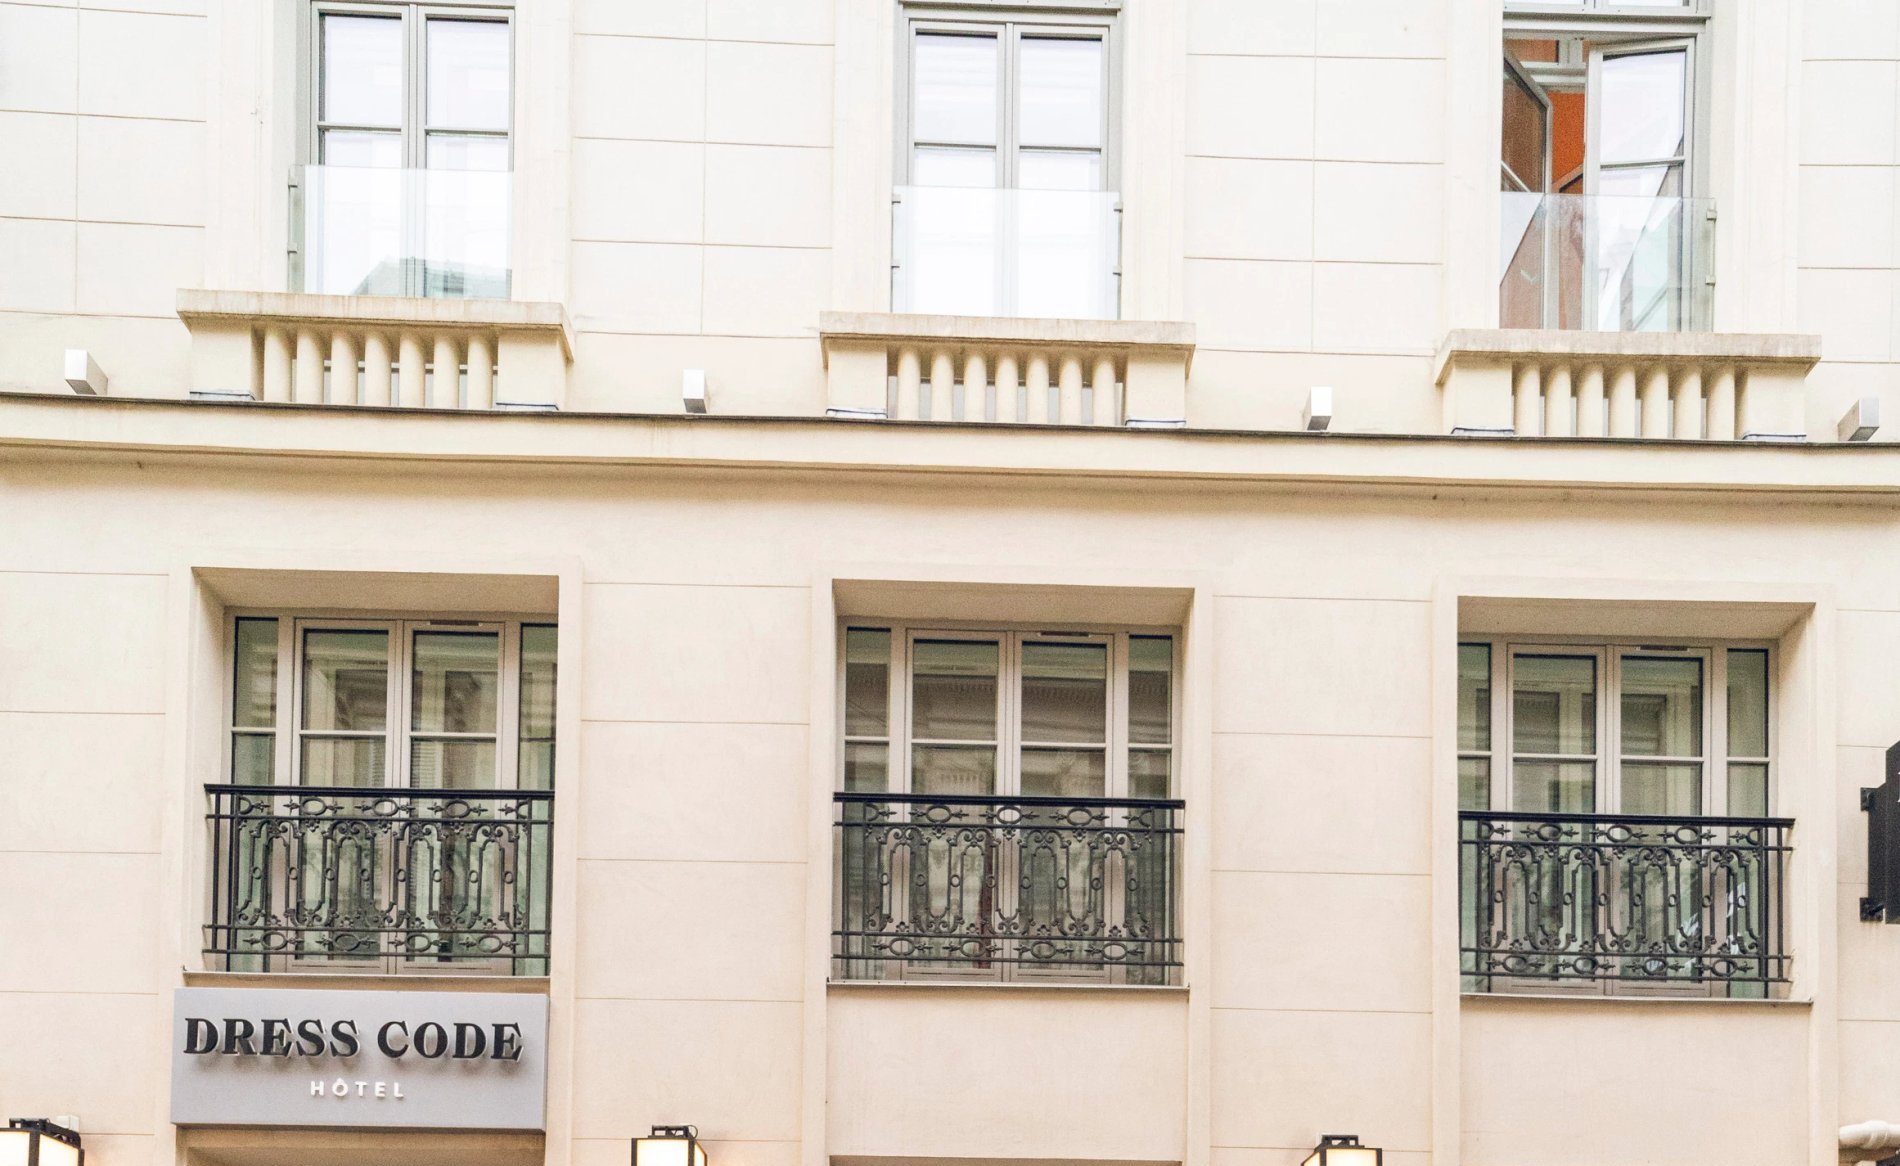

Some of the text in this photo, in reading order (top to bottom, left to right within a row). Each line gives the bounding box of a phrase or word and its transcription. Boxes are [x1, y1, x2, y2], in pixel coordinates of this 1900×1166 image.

[183, 1017, 524, 1063] DRESS CODE
[310, 1078, 404, 1099] HÔTEL
